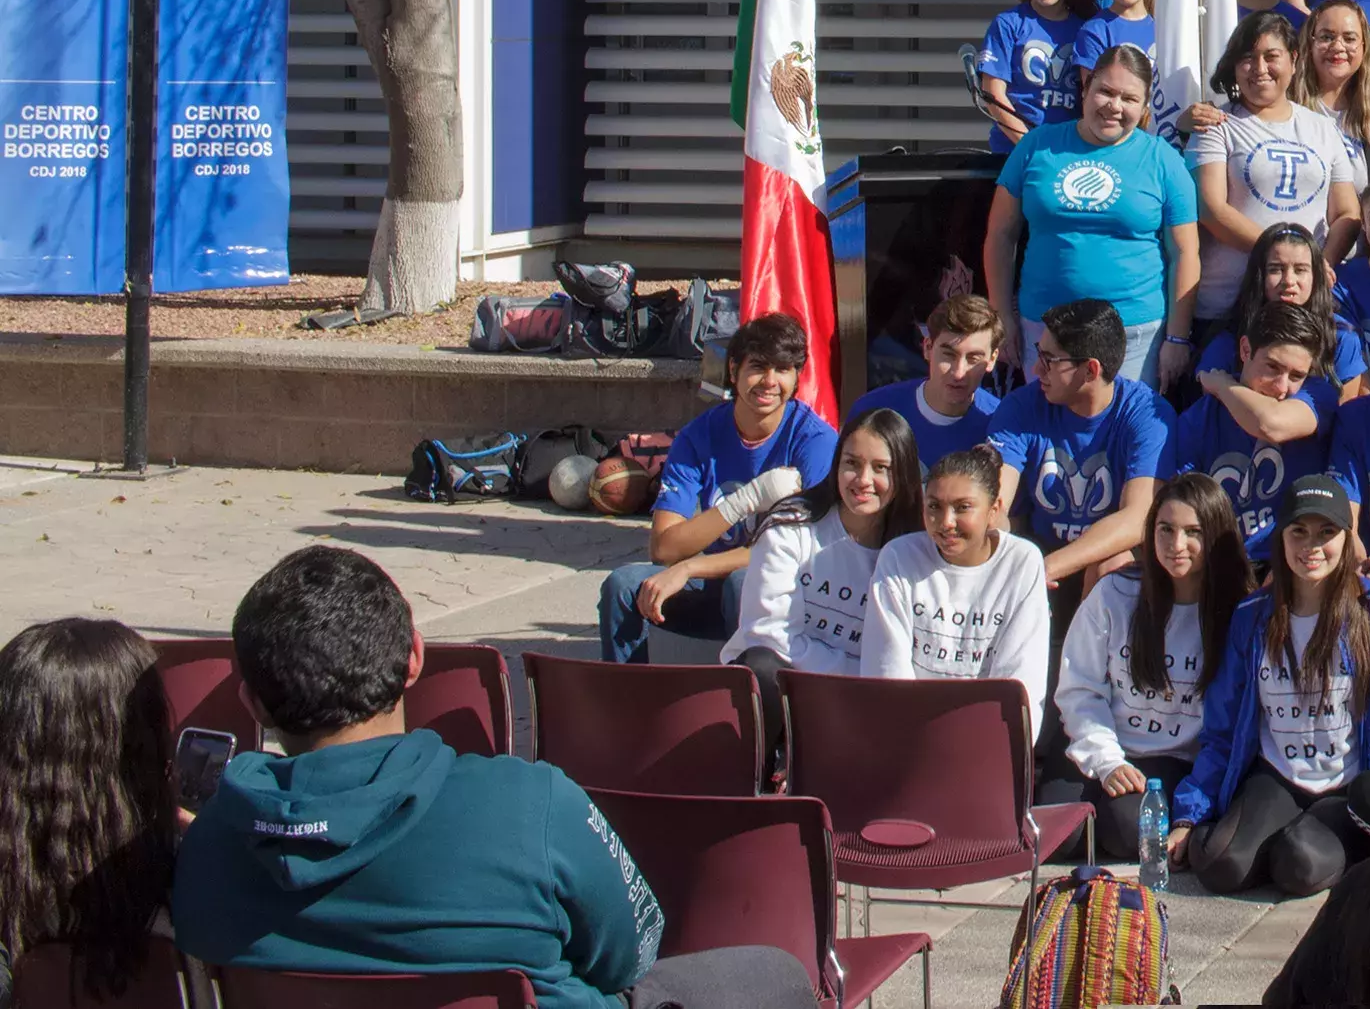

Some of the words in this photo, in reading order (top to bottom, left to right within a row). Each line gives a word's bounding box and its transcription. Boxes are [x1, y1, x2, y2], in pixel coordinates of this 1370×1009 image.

[1040, 89, 1076, 109] TEC
[20, 105, 98, 121] CENTRO
[184, 105, 261, 122] CENTRO
[3, 123, 111, 141] DEPORTIVO
[171, 123, 273, 140] DEPORTIVO
[3, 143, 110, 160] BORREGOS
[171, 141, 274, 159] BORREGOS
[29, 166, 57, 179] CDJ
[59, 166, 88, 178] 2018
[194, 164, 220, 177] CDJ
[222, 164, 251, 176] 2018
[1266, 148, 1309, 200] T
[913, 602, 1003, 627] CAOHS
[1128, 715, 1182, 738] CDJ
[1284, 743, 1337, 762] CDJ
